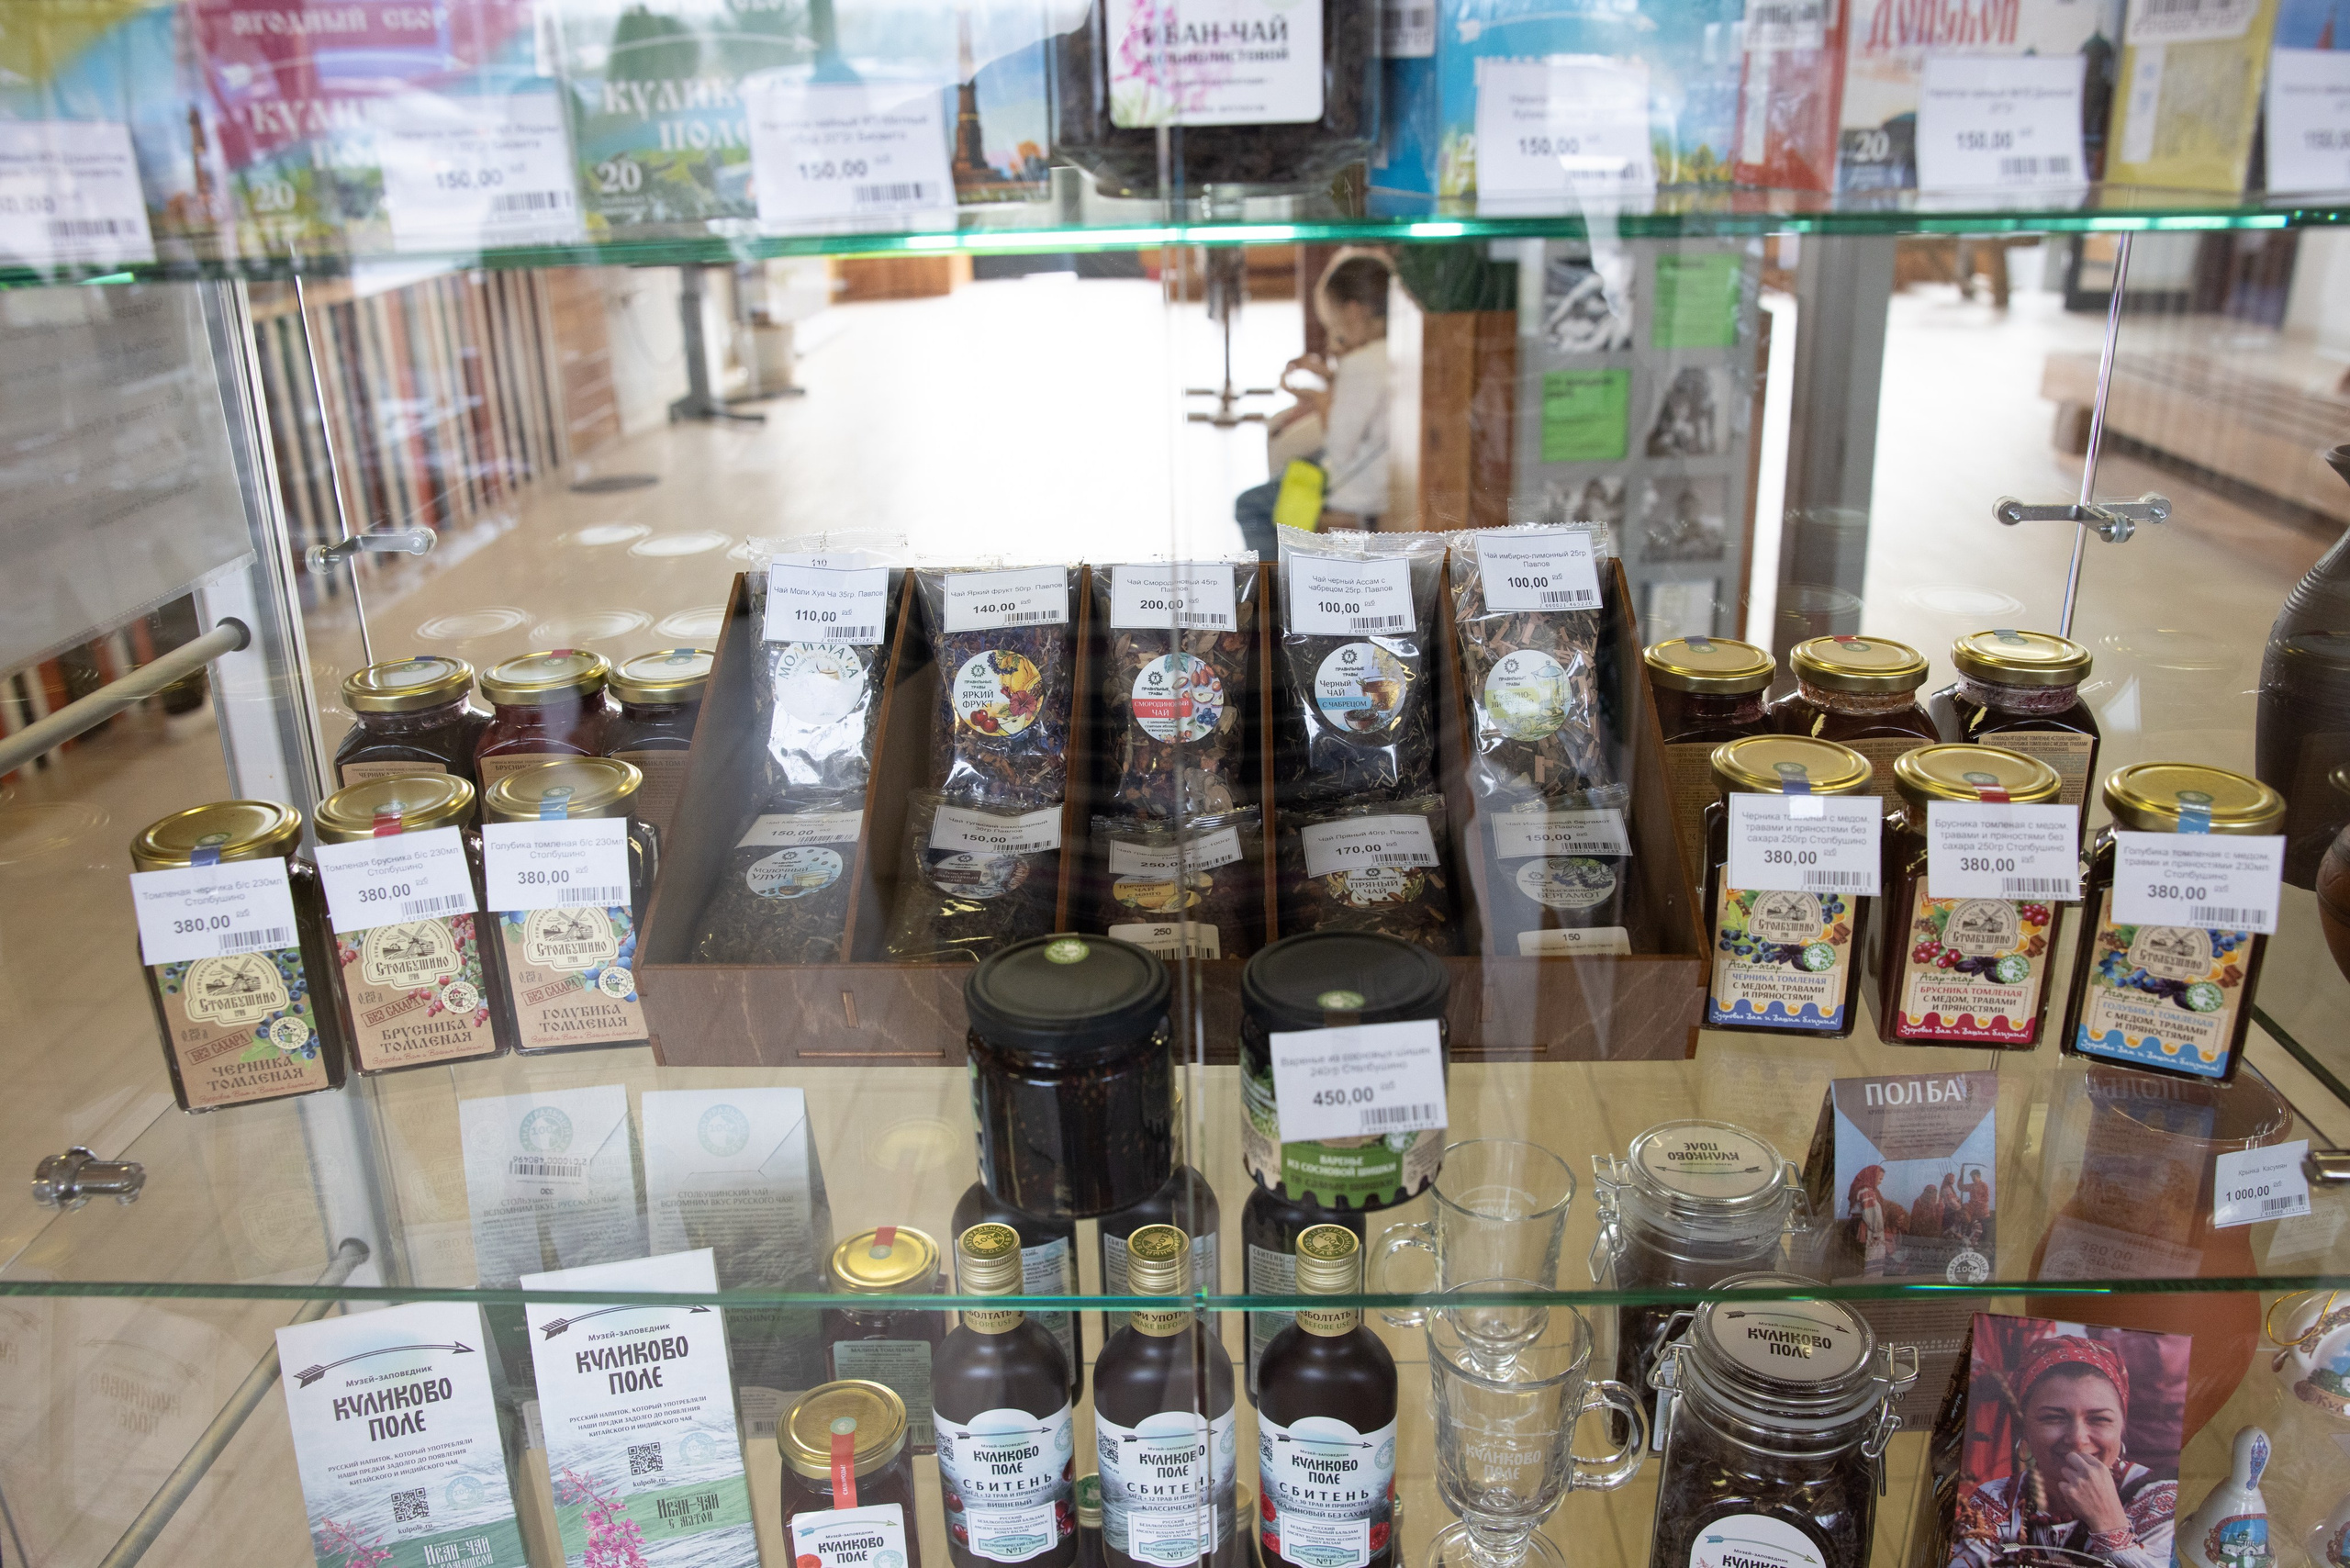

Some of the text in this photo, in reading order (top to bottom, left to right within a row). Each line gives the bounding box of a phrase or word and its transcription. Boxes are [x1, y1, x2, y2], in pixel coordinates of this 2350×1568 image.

[1518, 138, 1579, 156] 150,00
[1855, 131, 1889, 162] 20
[1956, 131, 2012, 151] 150,00
[433, 167, 505, 189] 150,00
[599, 162, 643, 193] 20
[799, 161, 868, 180] 150,00
[1500, 551, 1568, 560] имбирно-лимонный
[1571, 550, 1586, 558] 25гр
[1035, 582, 1062, 590] Павлов
[1309, 585, 1343, 593] чабрецом
[1507, 577, 1549, 589] 100,00
[973, 603, 1015, 613] 140,00
[1140, 599, 1183, 610] 200,00
[1318, 601, 1360, 614] 100,00
[795, 610, 836, 622] 110,00
[963, 700, 993, 709] ФРУКТ
[491, 837, 624, 851] Голубика томленая б/с 230мл
[962, 834, 1006, 843] 150,00
[530, 849, 586, 860] Столбушино
[1336, 845, 1382, 856] 170,00
[1978, 843, 2004, 852] 250гр
[2007, 843, 2065, 853] Столбушино
[324, 846, 459, 873] Томленая брусника б/с 230мл
[1764, 850, 1817, 866] 380,00
[1961, 858, 2015, 873] 380,00
[367, 863, 423, 877] Столбушино
[518, 870, 570, 886] 380,00
[236, 878, 282, 889] б/с 230мл
[185, 893, 245, 906] Столбушино
[359, 884, 411, 903] 380,00
[2148, 884, 2206, 901] 380,00
[174, 915, 230, 934] 380,00
[1729, 959, 1782, 974] Агар-агар
[1732, 973, 1827, 984] ЧЕРНИКА ТОМЛЕНАЯ
[527, 978, 578, 1002] БЕЗ САХАРА
[1741, 982, 1824, 993] МЕДОМ, ТРАВАМИ
[1920, 986, 2022, 997] БРУСНИКА ТОМЛЕНАЯ
[1751, 991, 1813, 1001] ПРЯНОСТЯМИ
[367, 997, 421, 1024] БЕЗ САХАРА
[543, 1004, 621, 1020] ГОЛУБИКА
[382, 1019, 467, 1040] БРУСНИКА
[539, 1017, 627, 1033] ТОМЛЕНАЯ
[191, 1035, 249, 1061] БЕЗ САХАРА
[380, 1031, 472, 1054] ТОМЛЕНАЯ
[212, 1057, 294, 1077] ЧЕРНИКА
[207, 1068, 304, 1091] ТОМЛЕНАЯ
[1313, 1086, 1373, 1106] 450,00
[1865, 1079, 1962, 1106] ПОЛБА
[1668, 1152, 1739, 1160] КУЛИКОВО
[2239, 1164, 2288, 1176] Крынка Касумян
[2226, 1185, 2269, 1202] 1 000,00
[1304, 1320, 1350, 1329] BEFORE USE
[1748, 1328, 1831, 1349] КУЛИКОВО
[576, 1336, 688, 1373] КУЛИКОВО
[1770, 1343, 1810, 1359] ПОЛЕ
[609, 1366, 663, 1394] ПОЛЕ
[333, 1378, 453, 1421] КУЛИКОВО
[369, 1410, 426, 1441] ПОЛЕ
[328, 1439, 473, 1472] РУССКИЙ НАПИТОК, КОТОРЫЙ УПОТРЕБЛЯЛИ
[974, 1445, 1039, 1462] КУЛИКОВО
[1466, 1443, 1540, 1465] КУЛИКОВО
[338, 1471, 358, 1479] НАШИ
[359, 1465, 386, 1474] ПРЕДКИ
[386, 1460, 416, 1470] ЗАДОЛГО
[429, 1449, 466, 1461] ПОЯВЛЕНИЯ
[991, 1462, 1023, 1474] ПОЛЕ
[1292, 1455, 1358, 1471] КУЛИКОВО
[350, 1473, 392, 1485] КИТАЙСКОГО
[400, 1462, 444, 1475] ИНДИЙСКОГО
[1309, 1472, 1340, 1484] ПОЛЕ
[632, 1478, 666, 1487] kulpole.ru
[964, 1473, 1051, 1491] СБИТЕНЬ
[1280, 1483, 1369, 1502] СБИТЕНЬ
[987, 1499, 1032, 1507] ВИШНЕВЫЙ
[1276, 1501, 1326, 1517] МАЛИНОВЫЙ
[1344, 1509, 1372, 1518] САХАРА
[398, 1524, 432, 1534] kulpole.ru
[818, 1536, 884, 1553] КУЛИКОВО
[836, 1551, 868, 1563] ПОЛЕ
